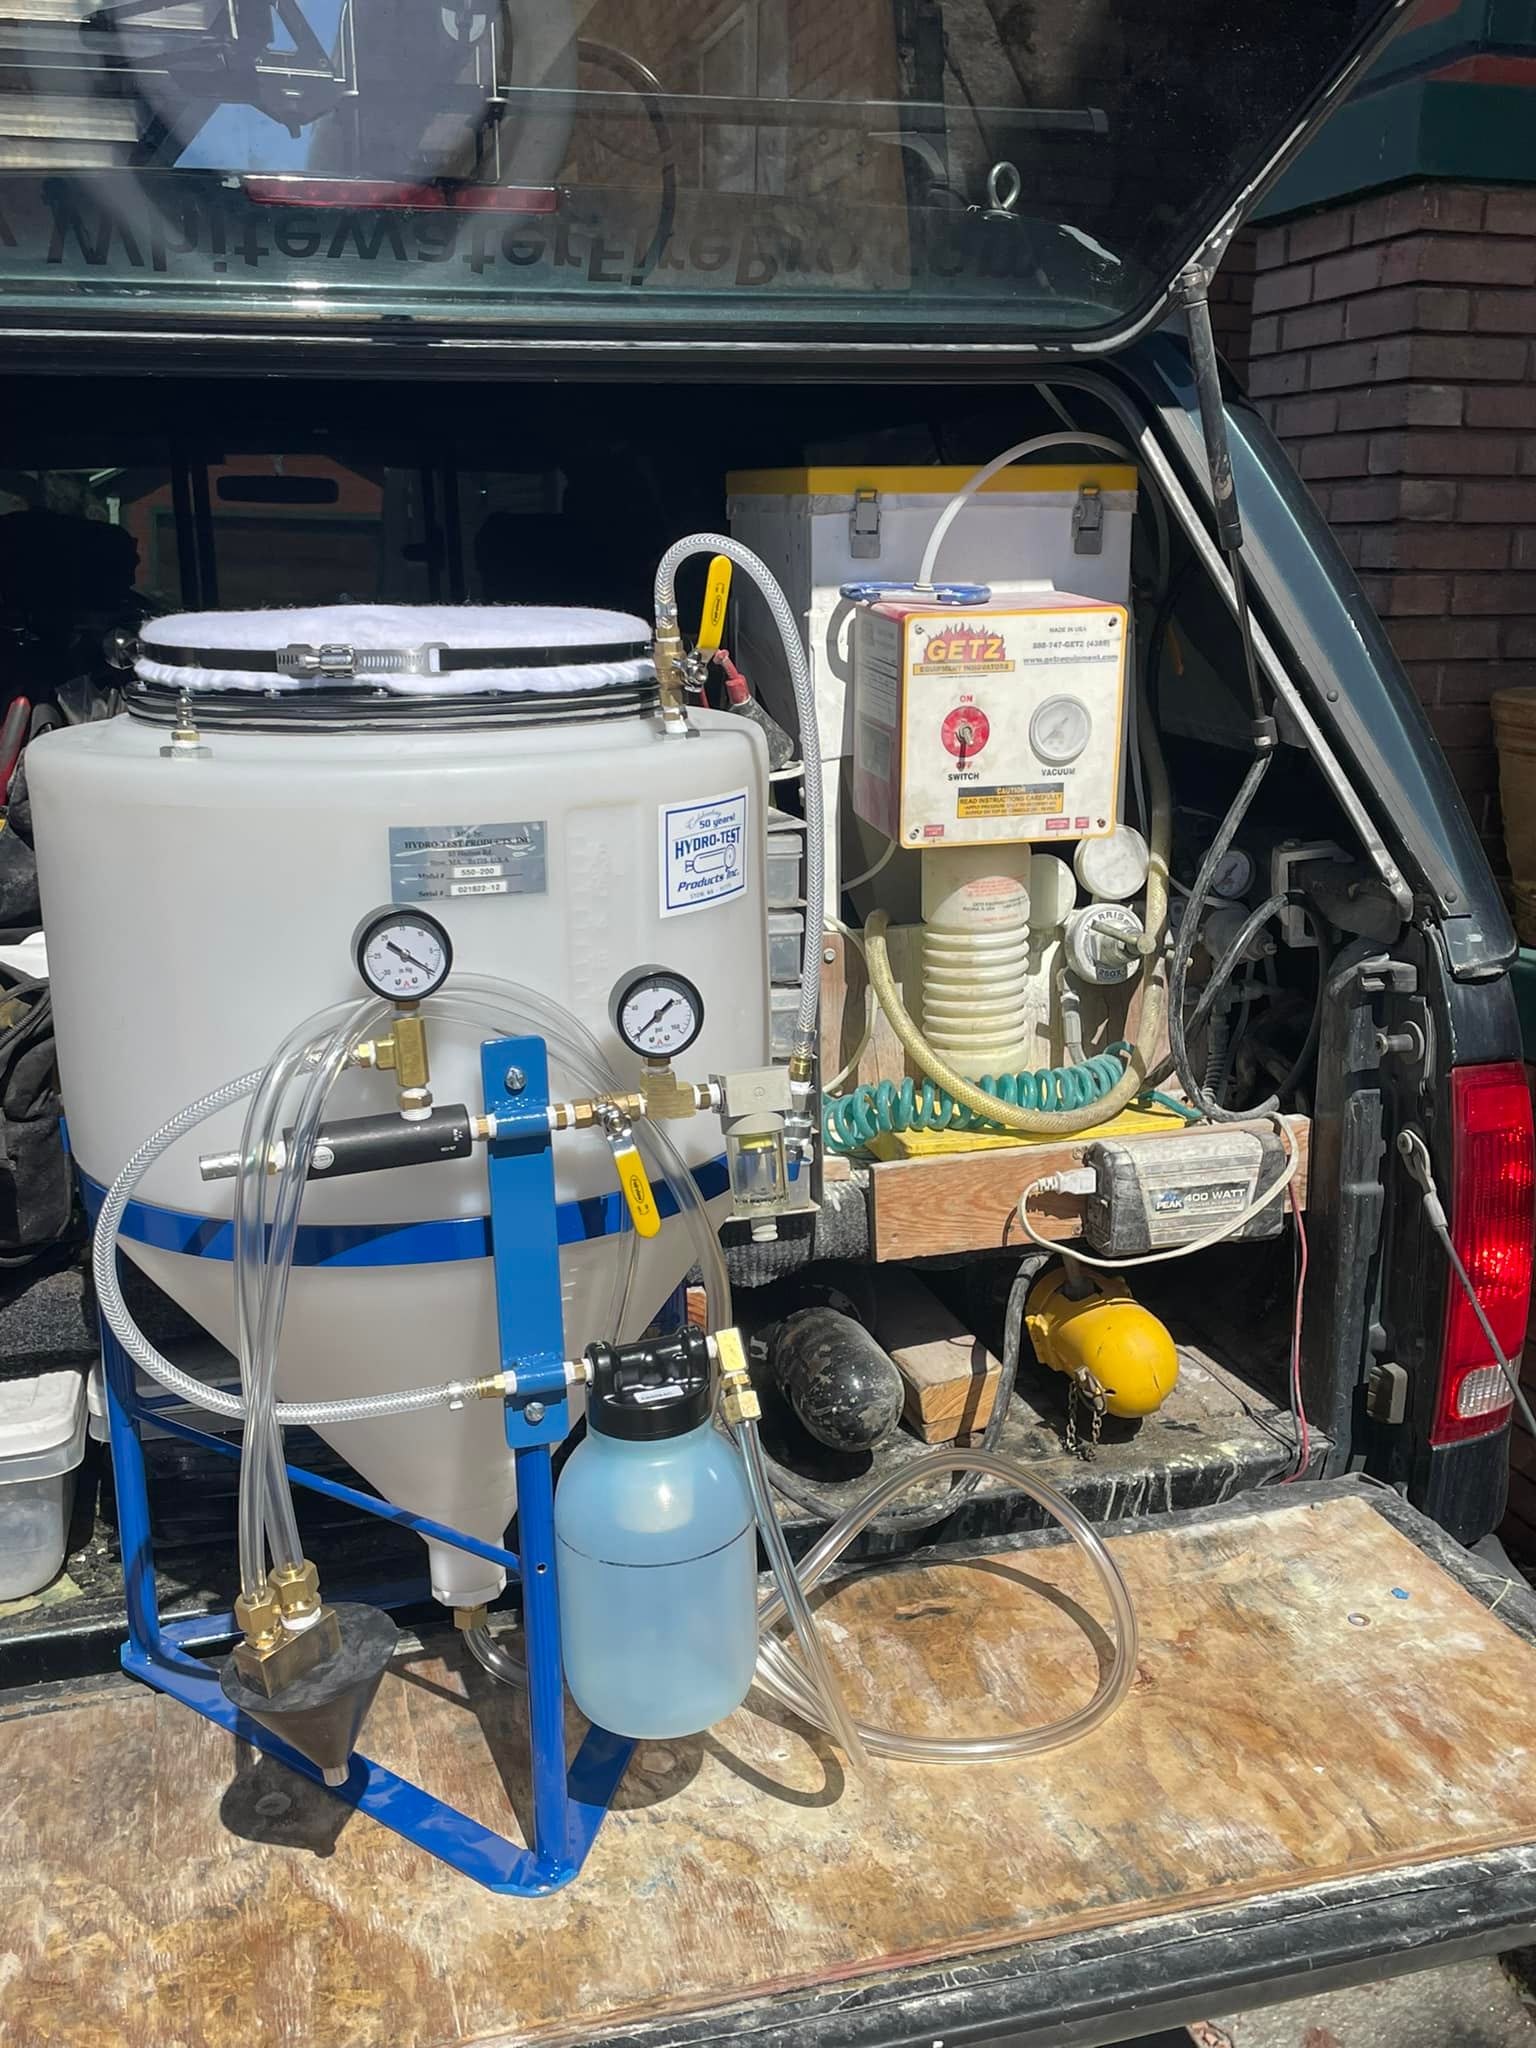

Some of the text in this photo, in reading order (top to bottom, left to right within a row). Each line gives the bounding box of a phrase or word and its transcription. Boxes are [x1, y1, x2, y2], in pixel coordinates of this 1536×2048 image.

[926, 638, 1003, 661] GETZ
[948, 772, 979, 781] SWITCH
[1041, 767, 1075, 777] VACUUM
[699, 812, 736, 829] 50 years!
[404, 839, 463, 849] HYDRO-TEST
[675, 826, 741, 860] HYDRO-TEST
[461, 867, 495, 876] 550-200
[677, 874, 724, 892] Products
[726, 867, 740, 880] Inc.
[1184, 1188, 1246, 1202] 400 WATT
[1156, 1200, 1182, 1210] PEAK
